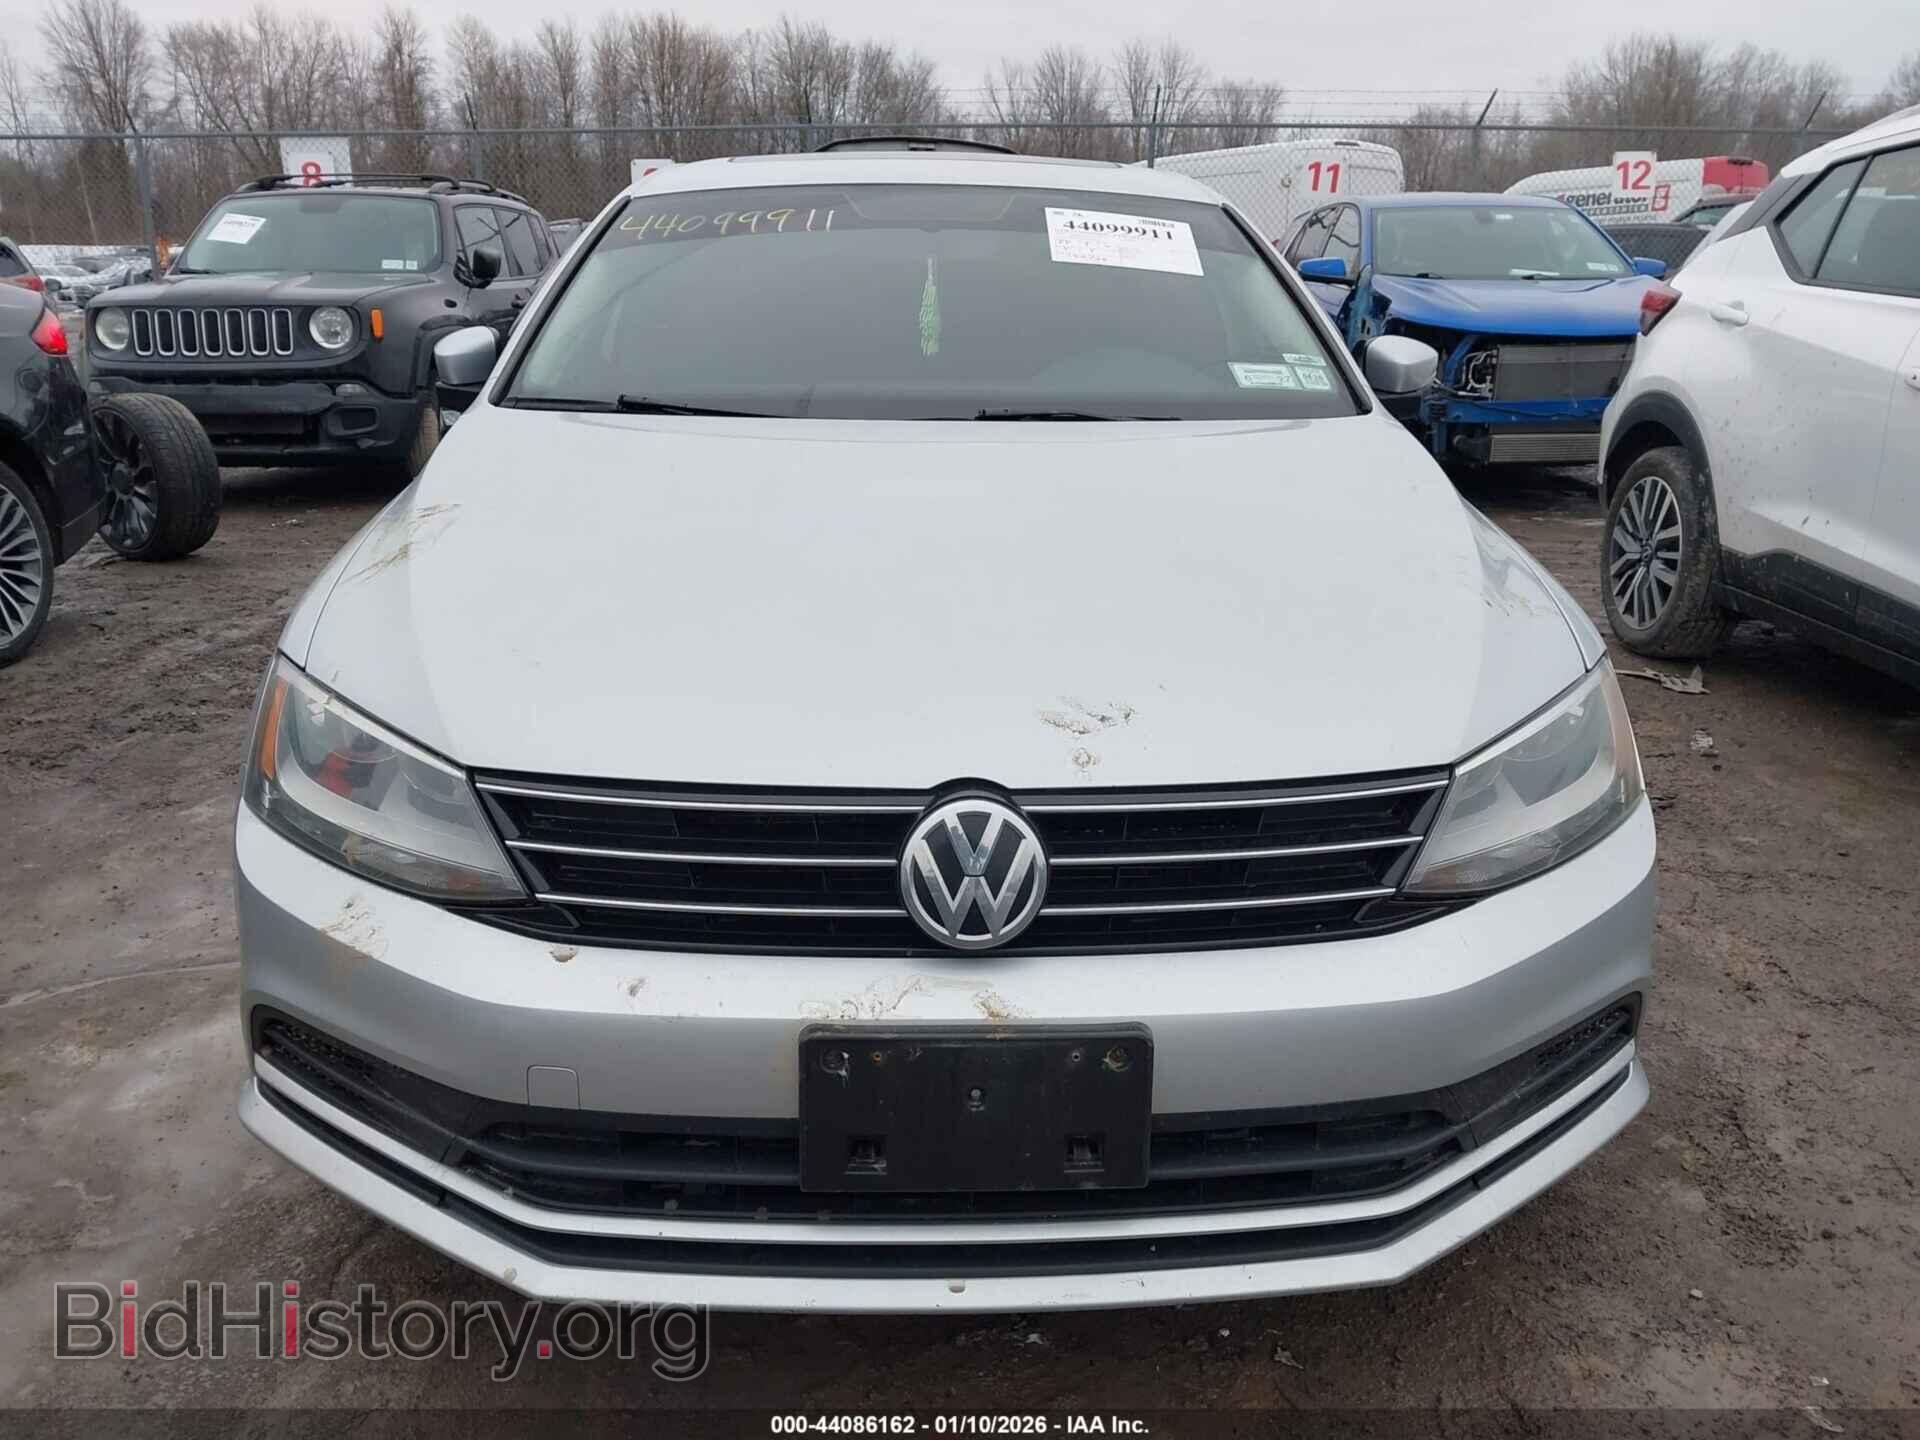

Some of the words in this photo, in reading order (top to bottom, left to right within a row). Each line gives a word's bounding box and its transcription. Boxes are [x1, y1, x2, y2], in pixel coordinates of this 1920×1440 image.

[302, 161, 321, 187] 8
[1308, 161, 1340, 193] 11
[1616, 160, 1651, 190] 12
[619, 207, 835, 240] 44099911
[1063, 219, 1175, 241] 44099911
